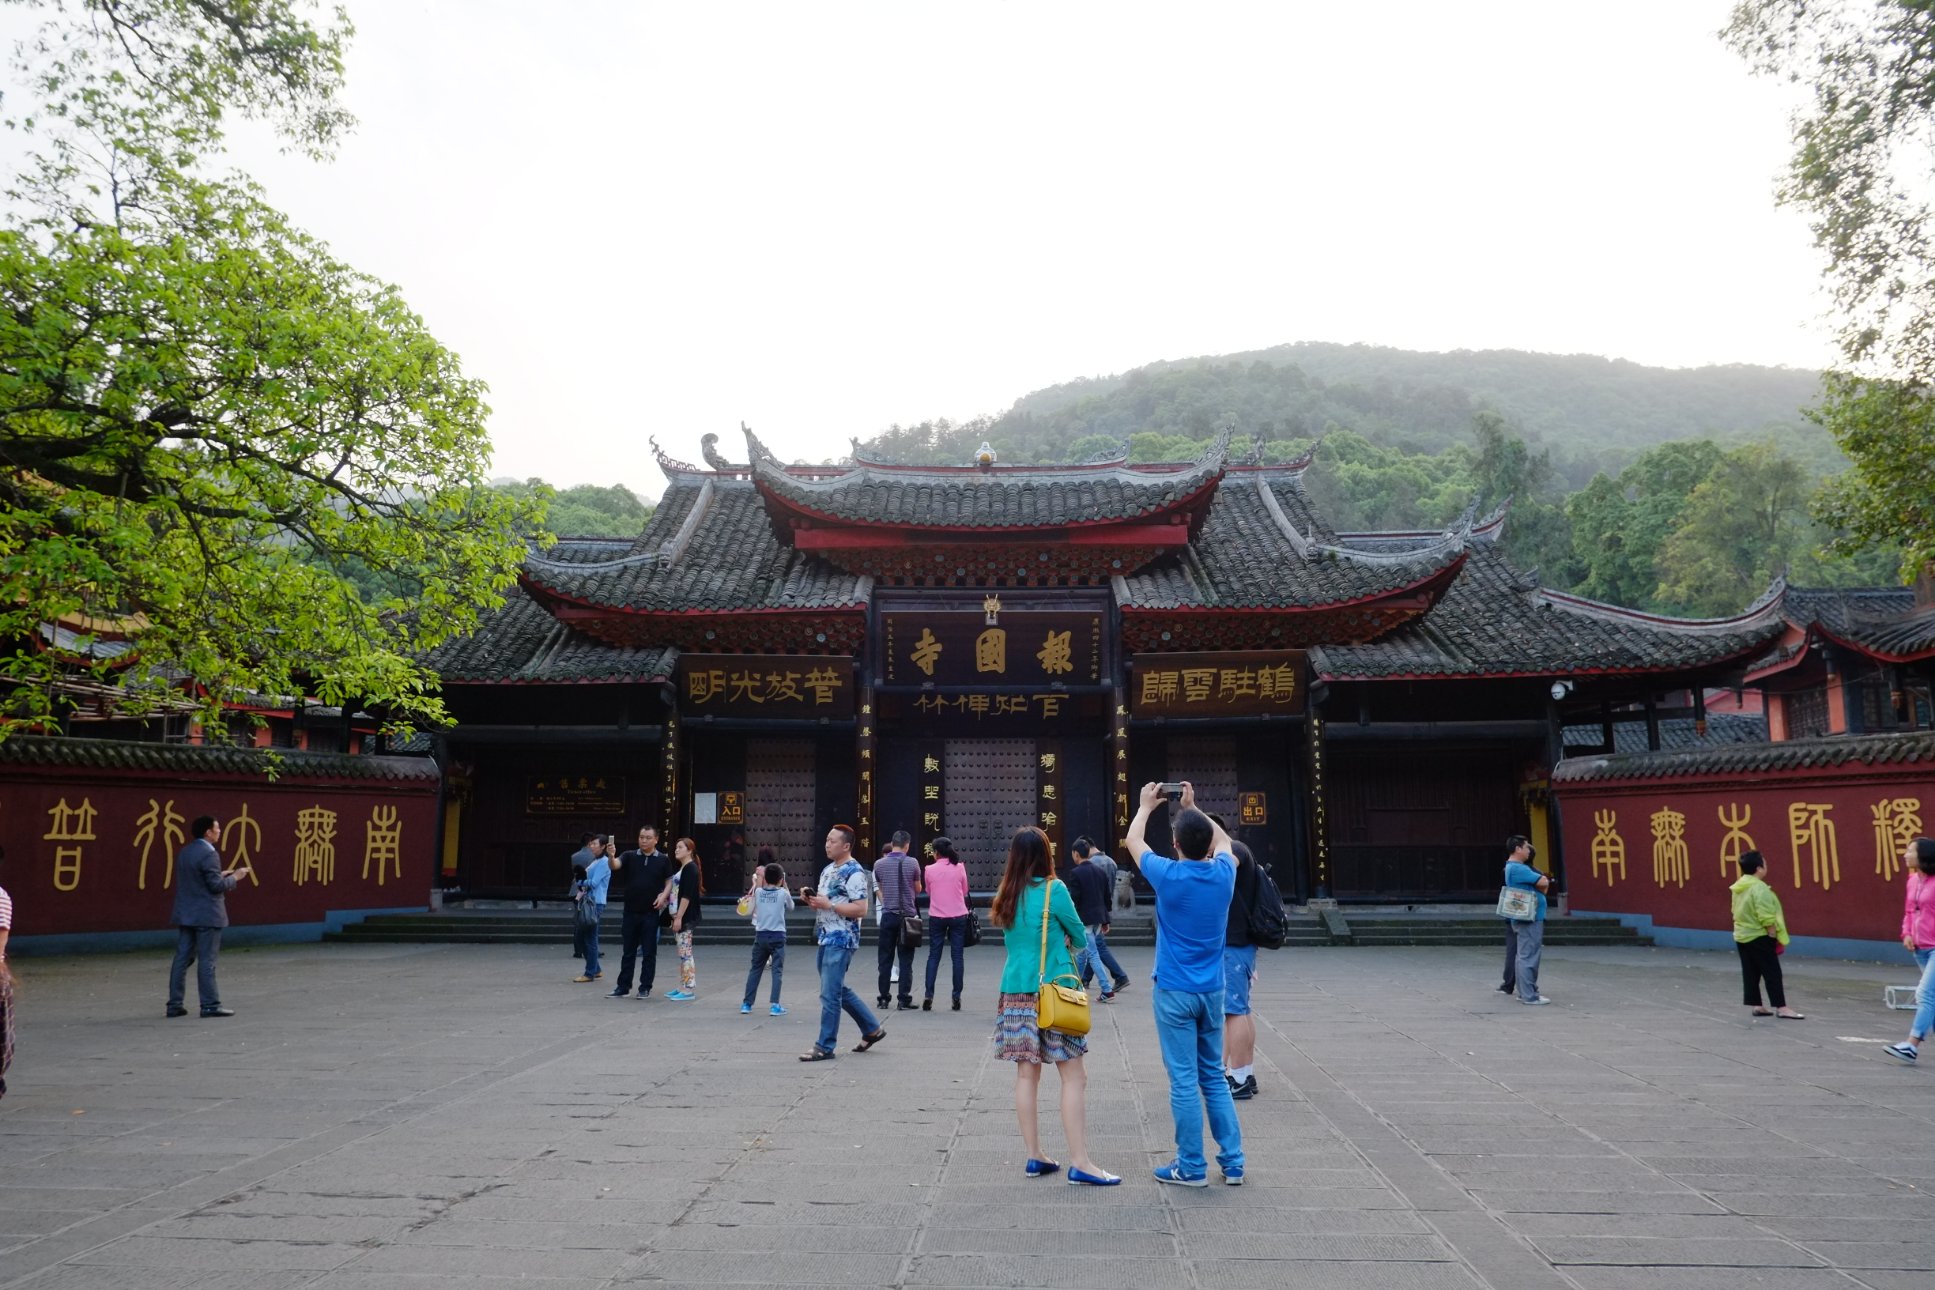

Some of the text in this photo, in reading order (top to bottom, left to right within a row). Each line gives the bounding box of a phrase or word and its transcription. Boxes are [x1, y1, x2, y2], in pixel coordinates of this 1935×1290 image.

[910, 627, 1074, 675] 報國寺
[688, 666, 843, 706] 普放光明
[1140, 661, 1295, 707] 鶴駐雲歸
[722, 805, 741, 815] 入口
[1243, 806, 1264, 816] 出口
